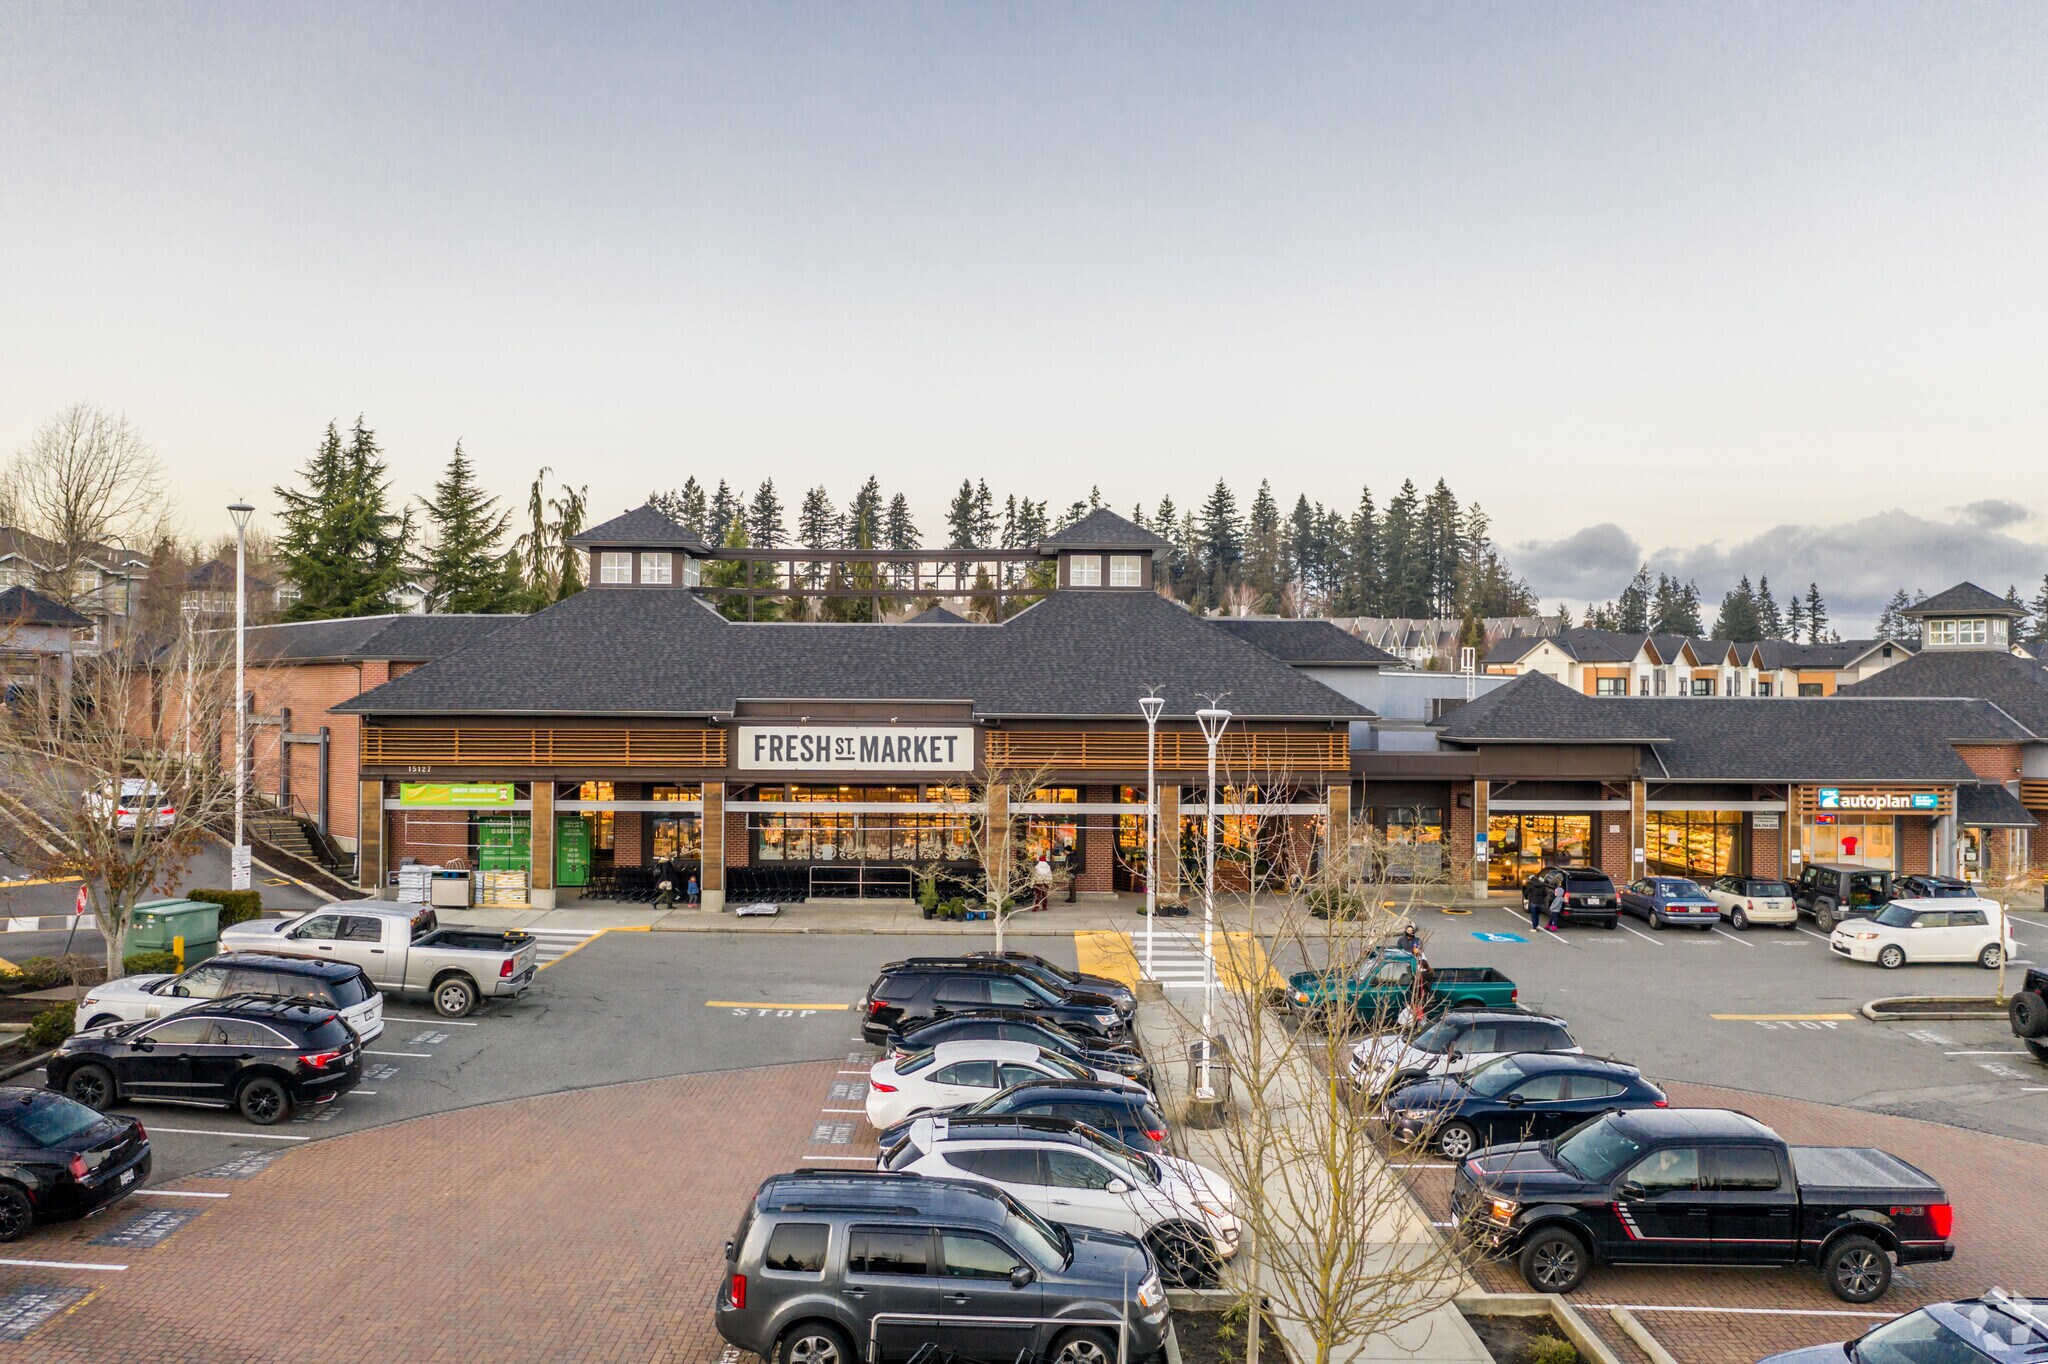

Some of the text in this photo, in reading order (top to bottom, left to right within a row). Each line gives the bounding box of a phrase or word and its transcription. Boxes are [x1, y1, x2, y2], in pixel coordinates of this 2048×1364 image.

[754, 734, 958, 763] FRESH ST. MARKET
[1840, 794, 1910, 810] autoplan
[732, 1008, 817, 1018] STOP
[1754, 1020, 1839, 1030] STOP
